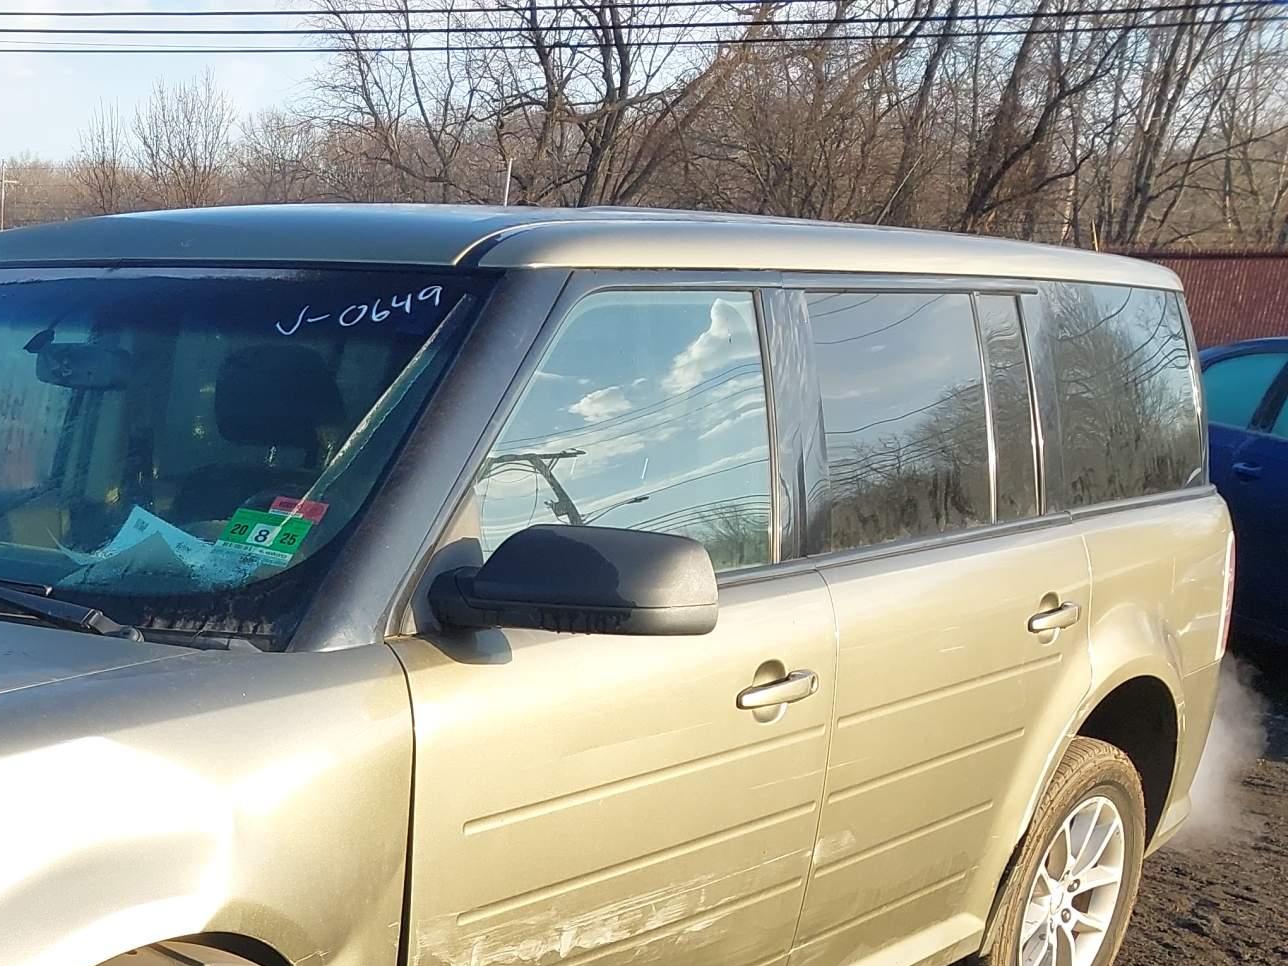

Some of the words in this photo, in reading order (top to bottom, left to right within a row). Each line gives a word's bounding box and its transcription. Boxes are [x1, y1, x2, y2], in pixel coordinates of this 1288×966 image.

[230, 523, 249, 536] 20
[254, 529, 270, 543] 8
[279, 533, 297, 546] 25
